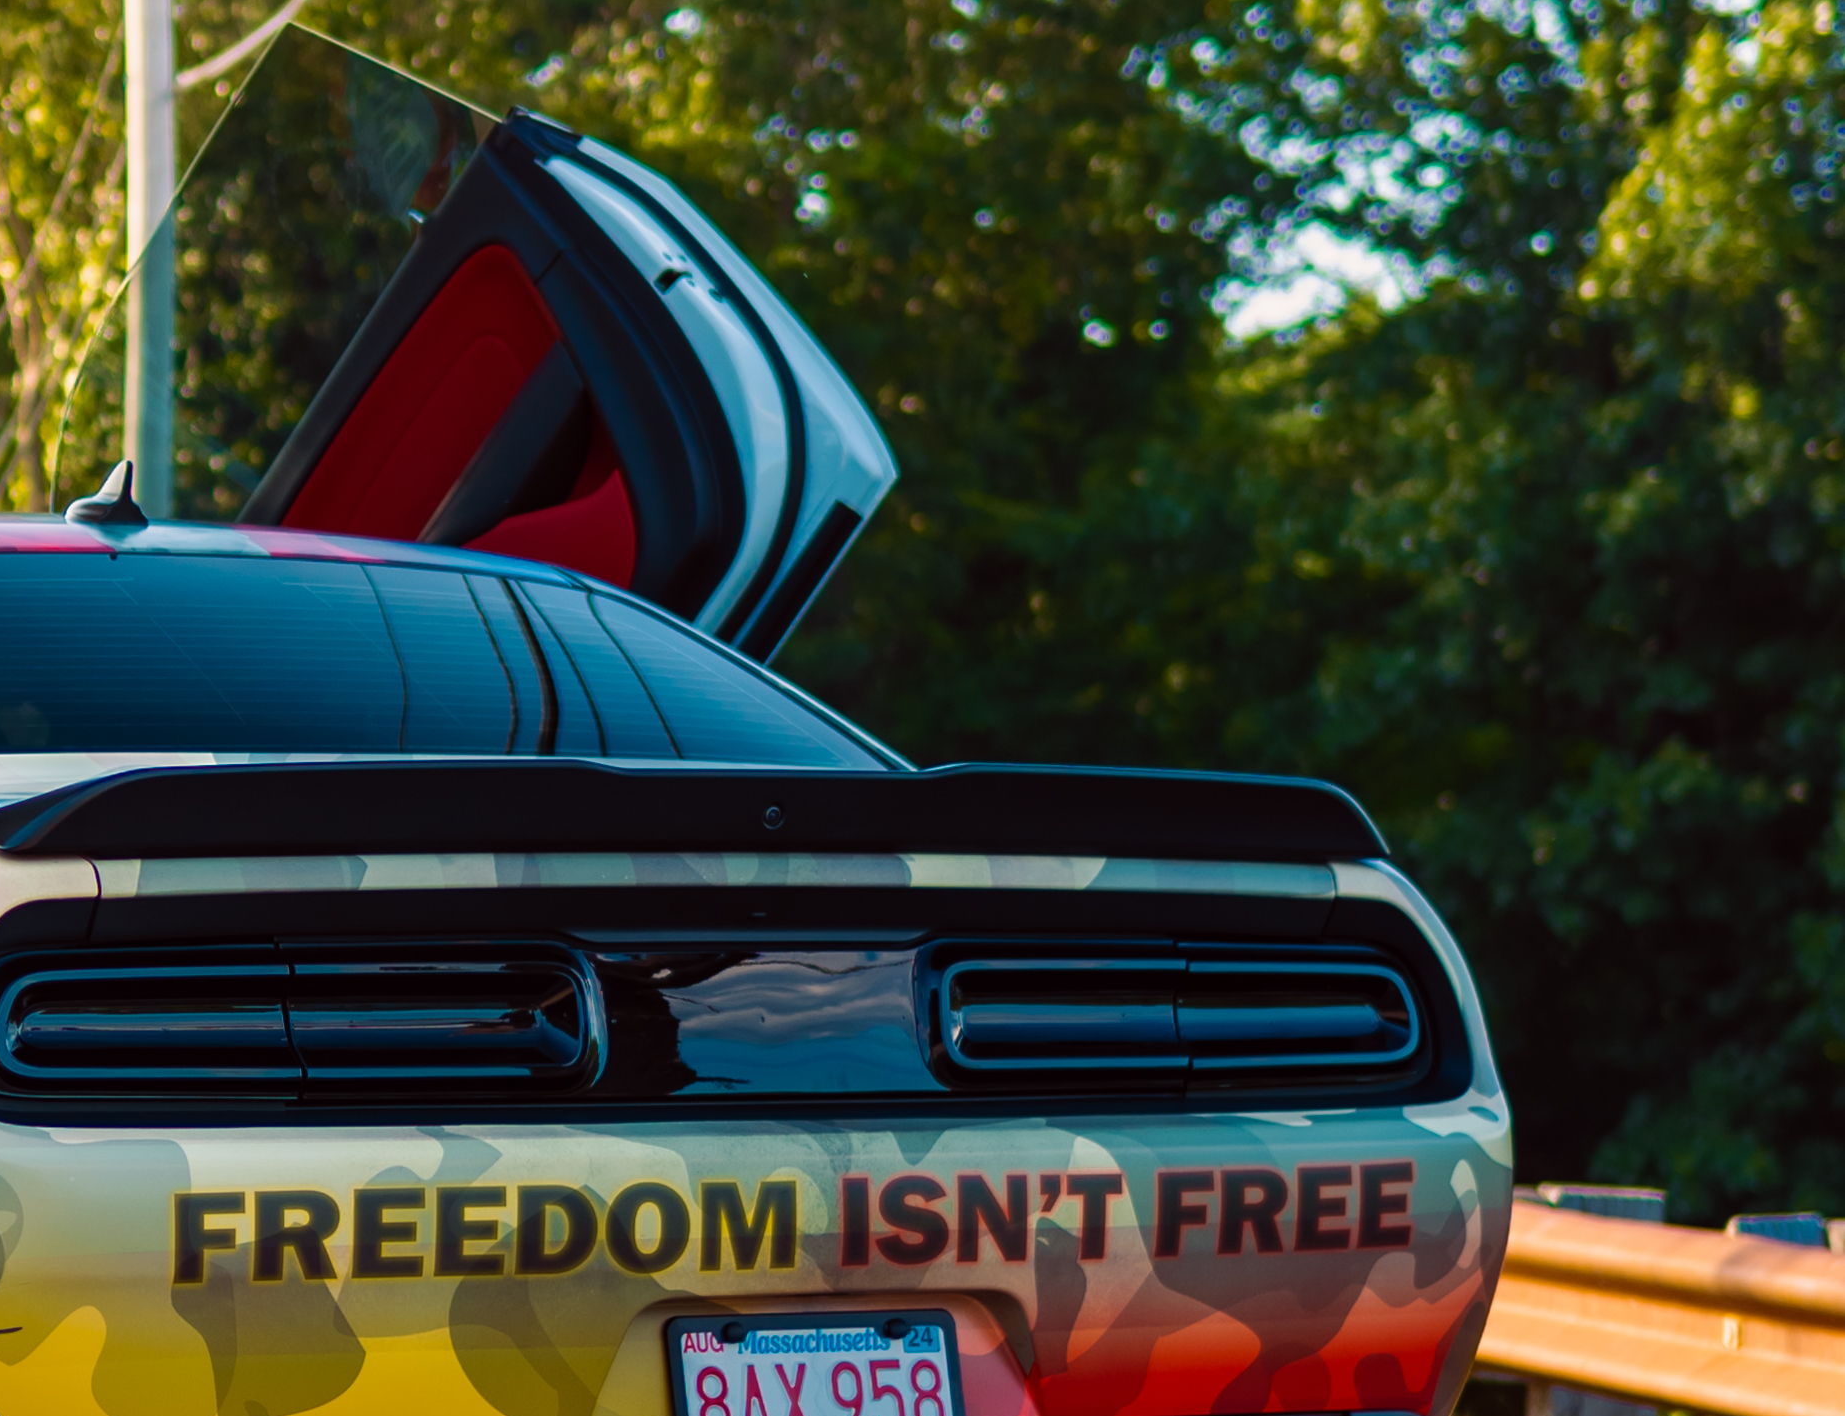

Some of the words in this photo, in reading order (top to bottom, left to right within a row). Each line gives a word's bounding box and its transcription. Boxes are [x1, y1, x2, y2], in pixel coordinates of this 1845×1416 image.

[172, 1180, 798, 1285] FREEDOM
[840, 1173, 1124, 1267] ISN'T
[1154, 1161, 1416, 1259] FREE
[683, 1331, 725, 1354] AUG
[737, 1327, 892, 1354] Massachusetts
[907, 1326, 934, 1348] 24
